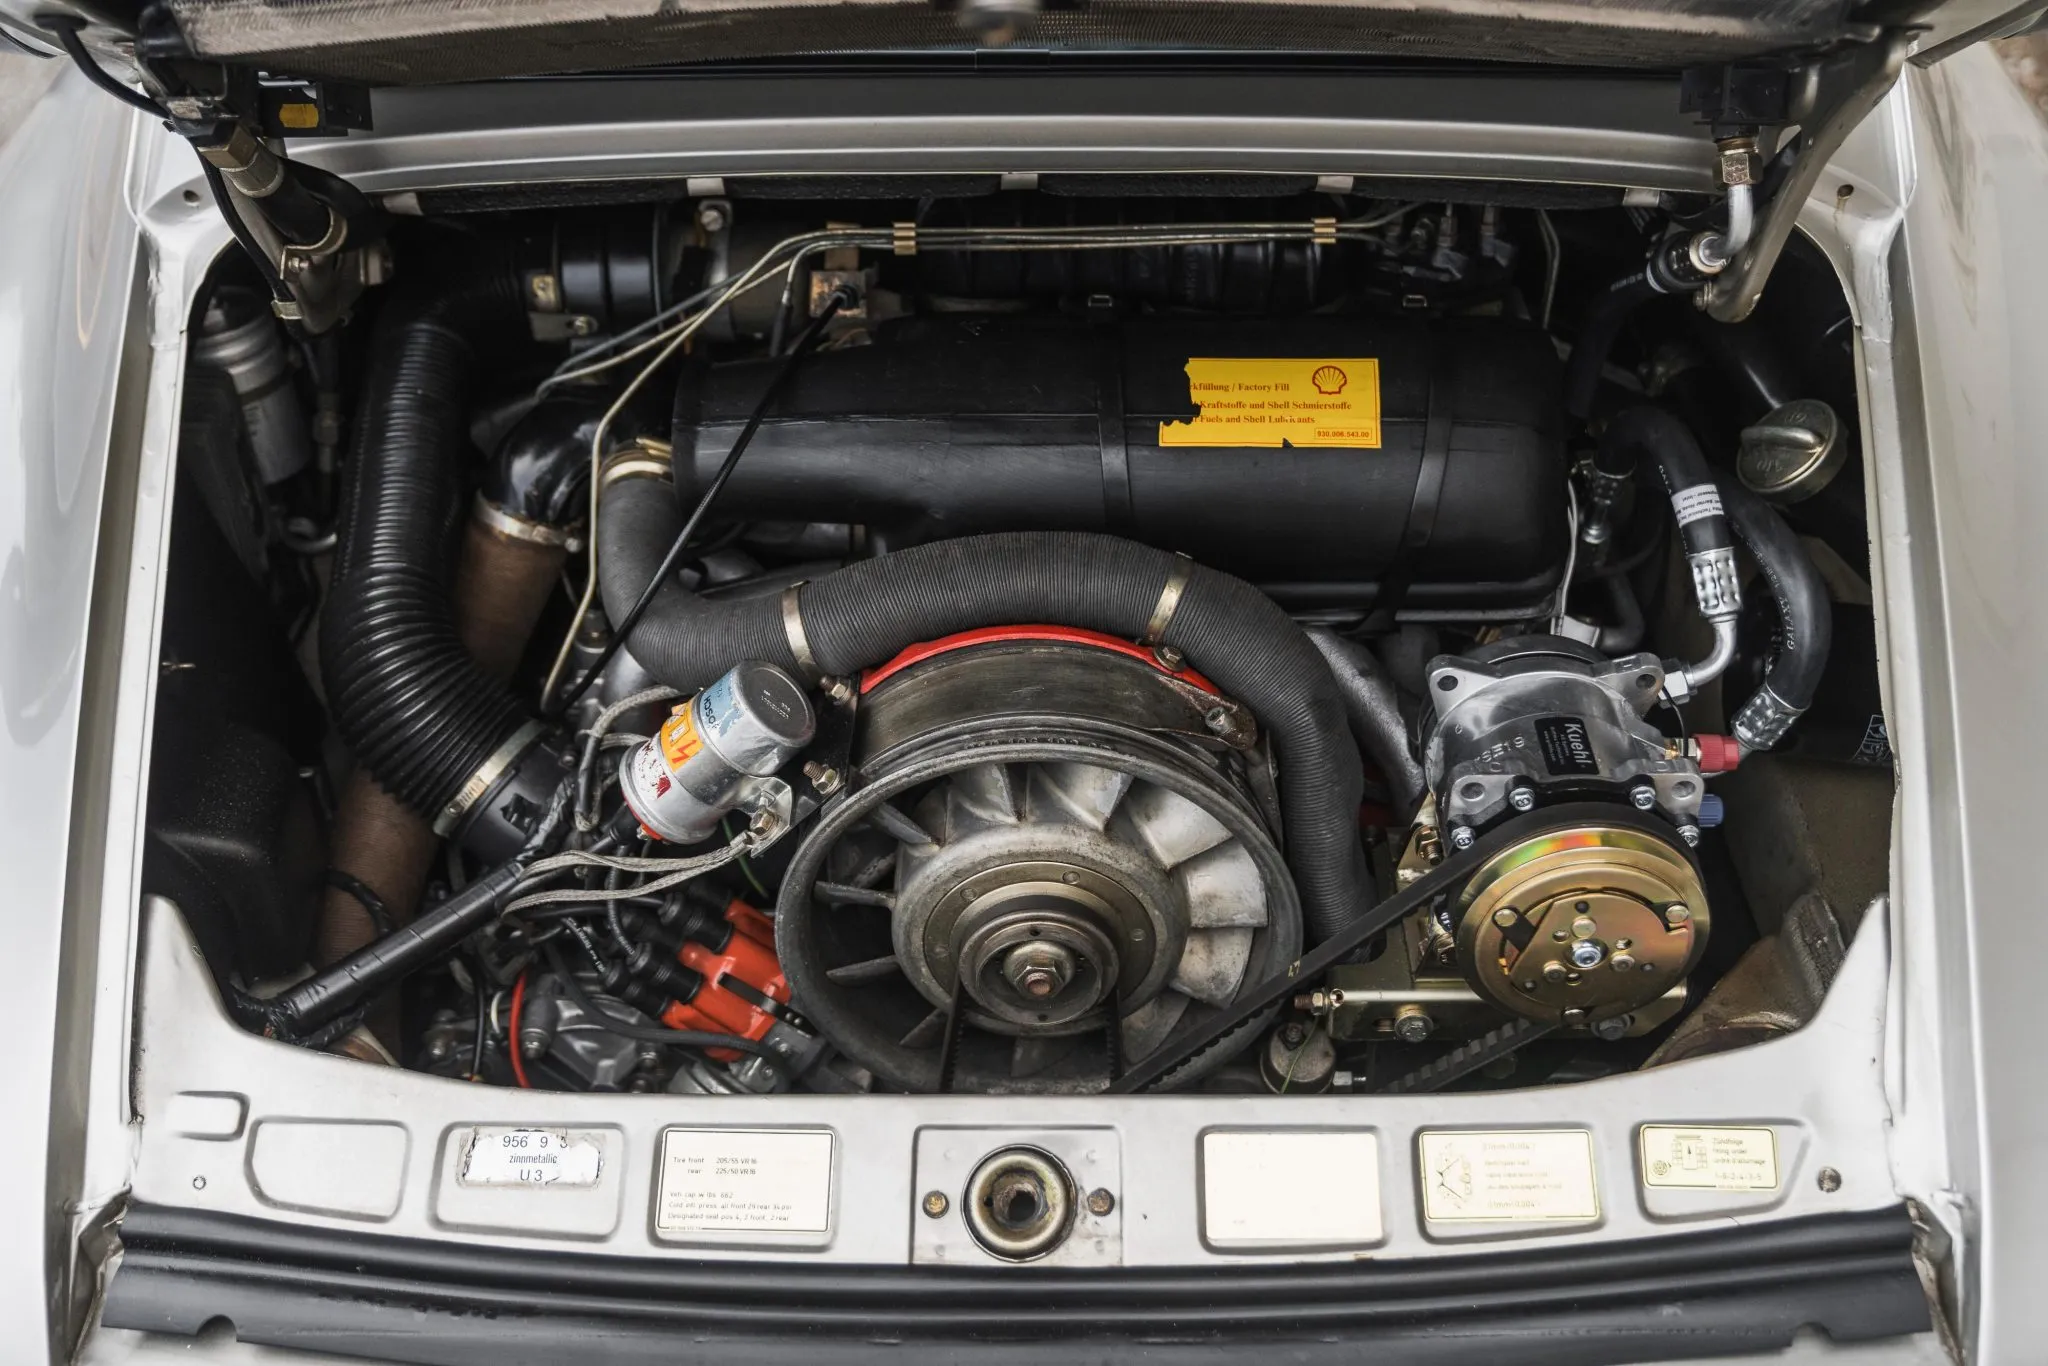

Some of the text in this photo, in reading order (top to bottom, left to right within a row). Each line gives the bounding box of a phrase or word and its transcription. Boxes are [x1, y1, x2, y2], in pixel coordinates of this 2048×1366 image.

[1238, 383, 1273, 393] Factory
[1275, 383, 1290, 392] Fill
[1200, 401, 1352, 410] Kraftstoffe und Shell Schmierstoffe
[1200, 415, 1223, 423] Fuels
[1225, 415, 1241, 423] and
[1243, 415, 1266, 423] Shell
[703, 695, 719, 728] OSCH
[1564, 723, 1593, 763] Kuehl
[502, 1135, 529, 1148] 956
[540, 1136, 549, 1148] 9
[509, 1153, 558, 1164] zinnmetallic
[520, 1169, 543, 1182] U 3
